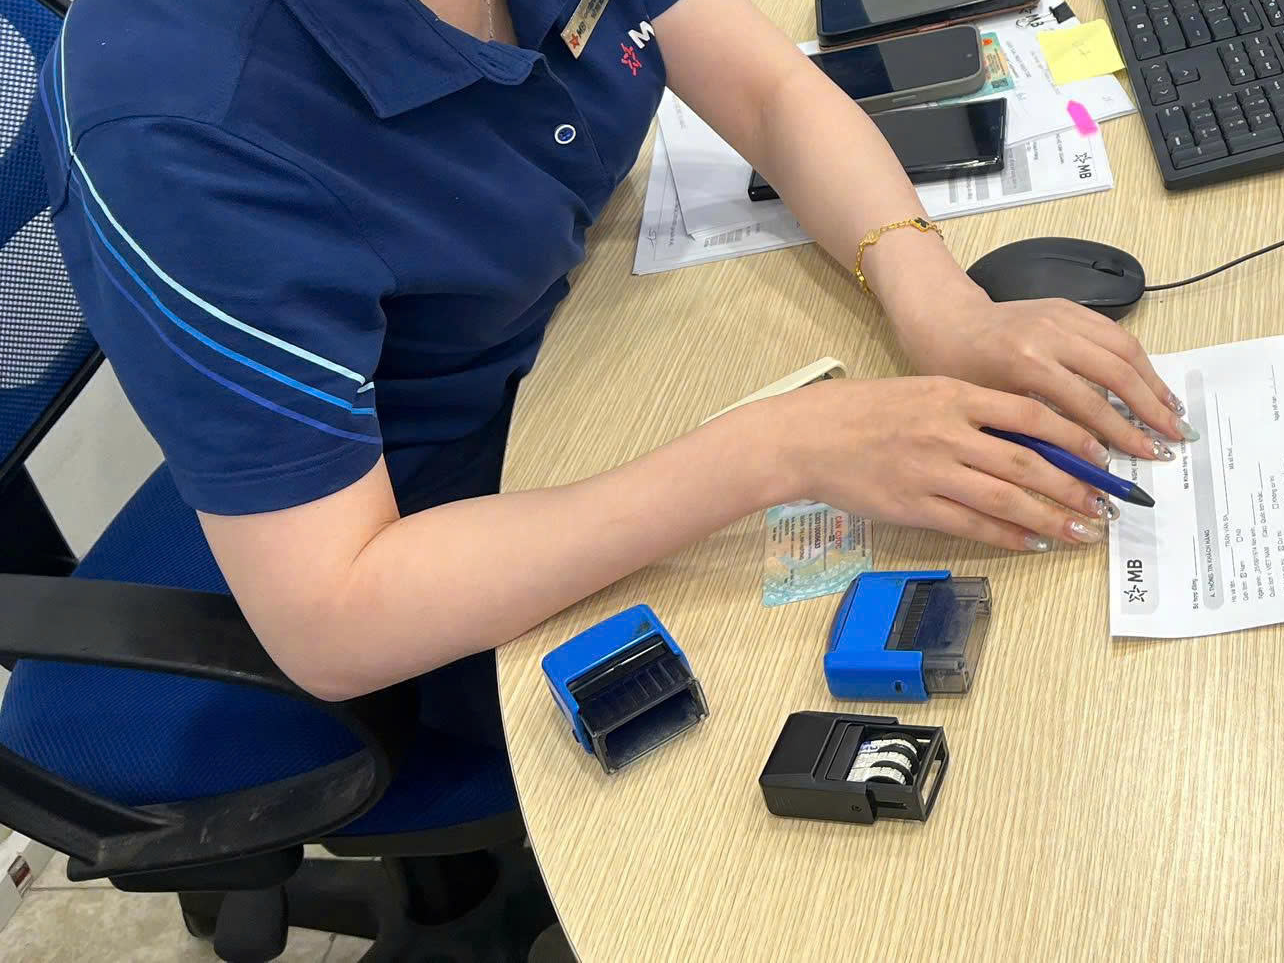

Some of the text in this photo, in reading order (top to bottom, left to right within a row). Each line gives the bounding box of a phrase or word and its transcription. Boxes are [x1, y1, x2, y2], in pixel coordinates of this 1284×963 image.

[573, 20, 588, 38] MB
[1078, 162, 1093, 179] MB
[1127, 559, 1143, 582] MB
